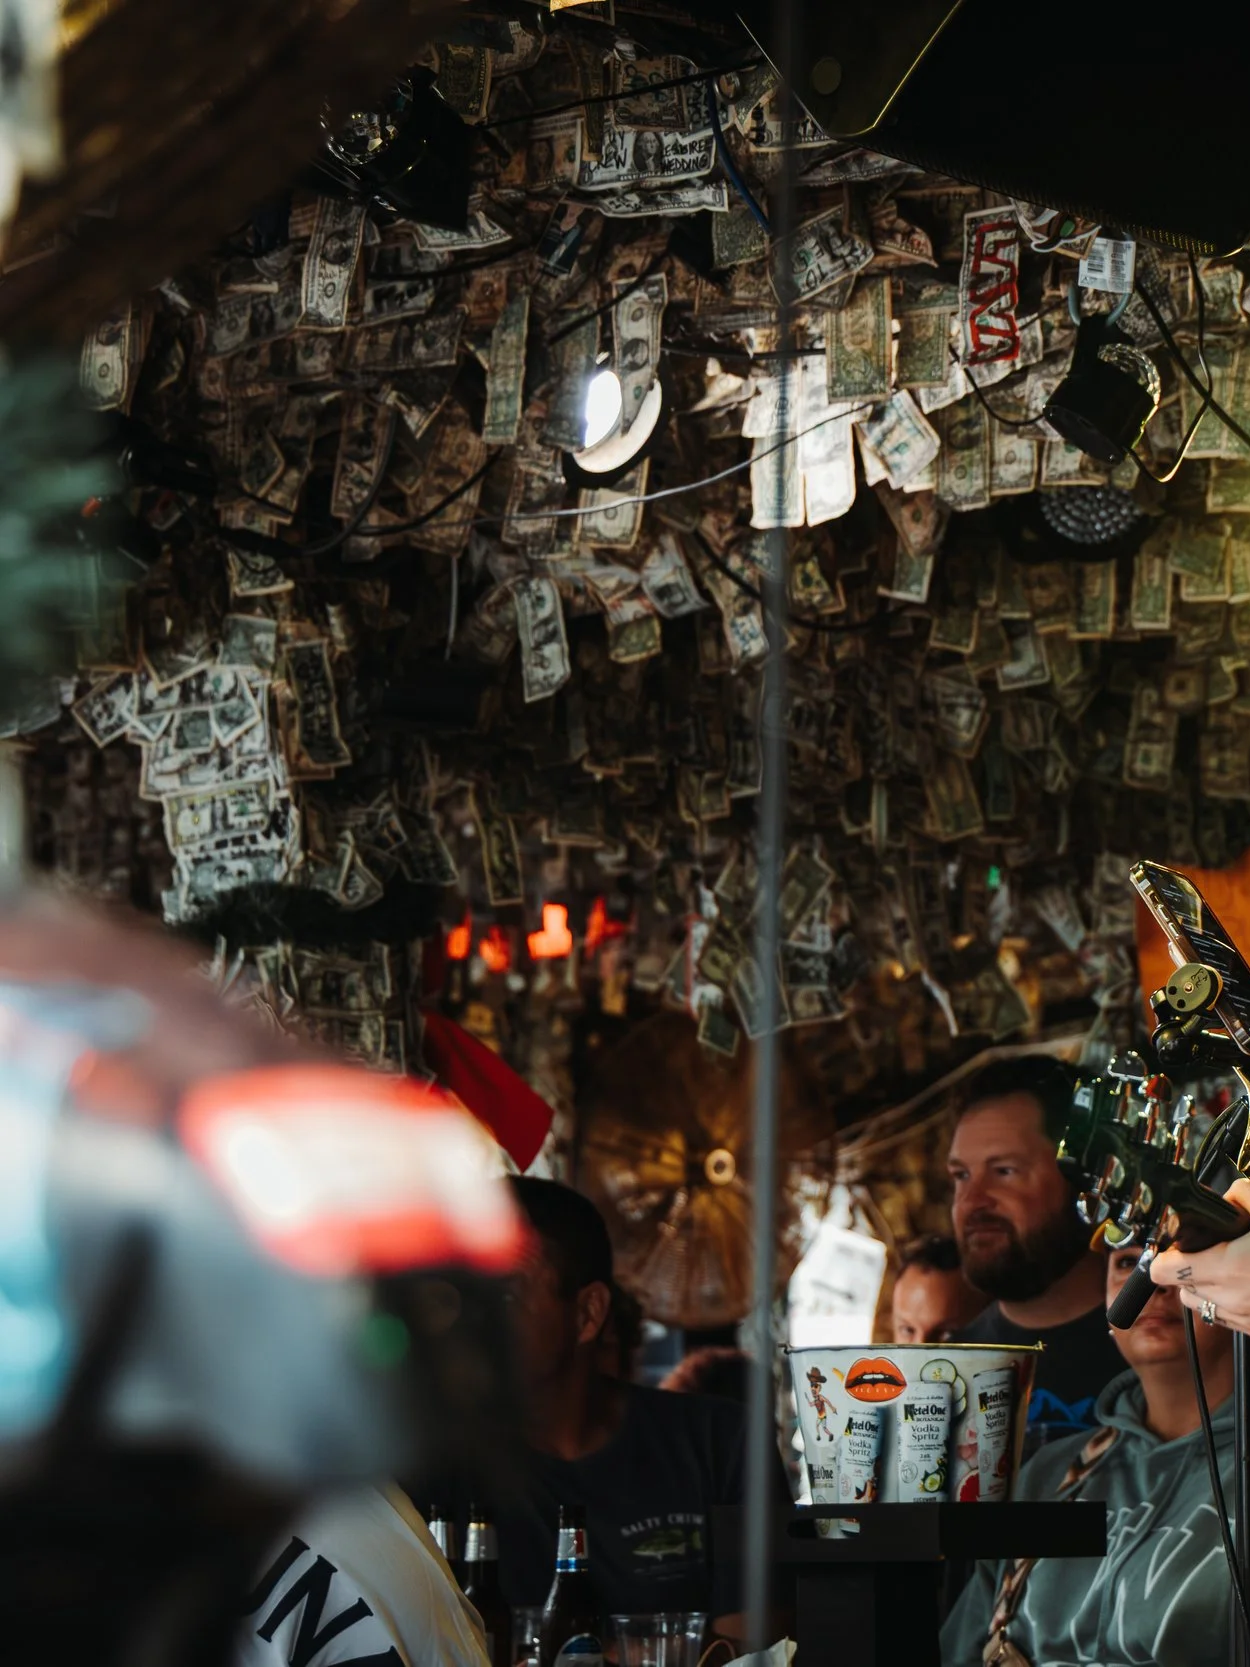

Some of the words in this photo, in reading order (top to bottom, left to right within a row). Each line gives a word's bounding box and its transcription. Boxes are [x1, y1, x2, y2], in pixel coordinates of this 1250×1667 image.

[904, 1403, 930, 1421] Ketel
[930, 1404, 946, 1415] One
[844, 1416, 864, 1436] Ketel
[864, 1420, 880, 1432] One
[911, 1423, 940, 1433] Vodka
[911, 1432, 940, 1442] Spritz
[848, 1439, 872, 1450] Vodka
[848, 1447, 872, 1457] Spritz
